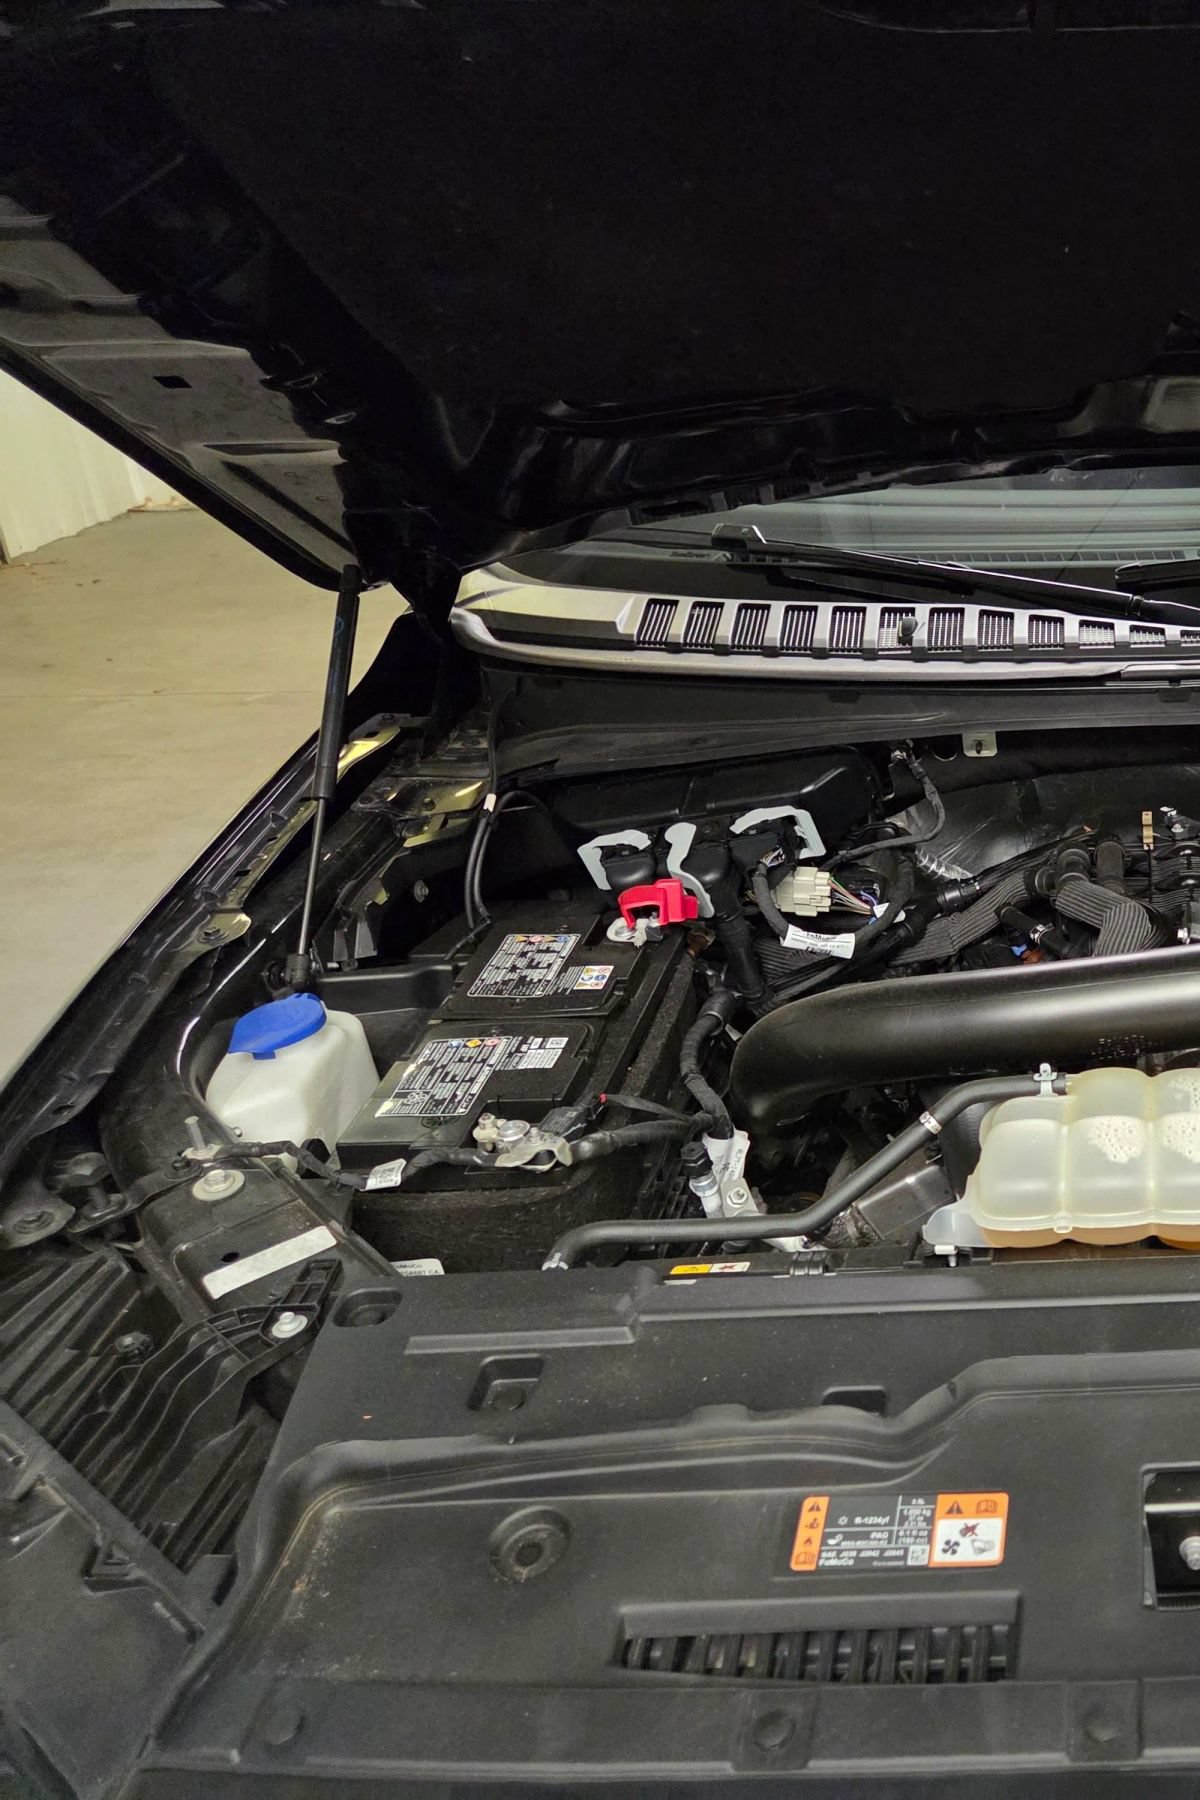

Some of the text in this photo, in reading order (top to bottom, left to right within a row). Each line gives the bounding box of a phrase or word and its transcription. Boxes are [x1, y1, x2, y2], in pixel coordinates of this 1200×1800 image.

[854, 1516, 890, 1525] R-1234yf
[870, 1531, 889, 1540] PAG
[820, 1550, 838, 1558] SAE
[818, 1558, 854, 1566] FoMoCo
